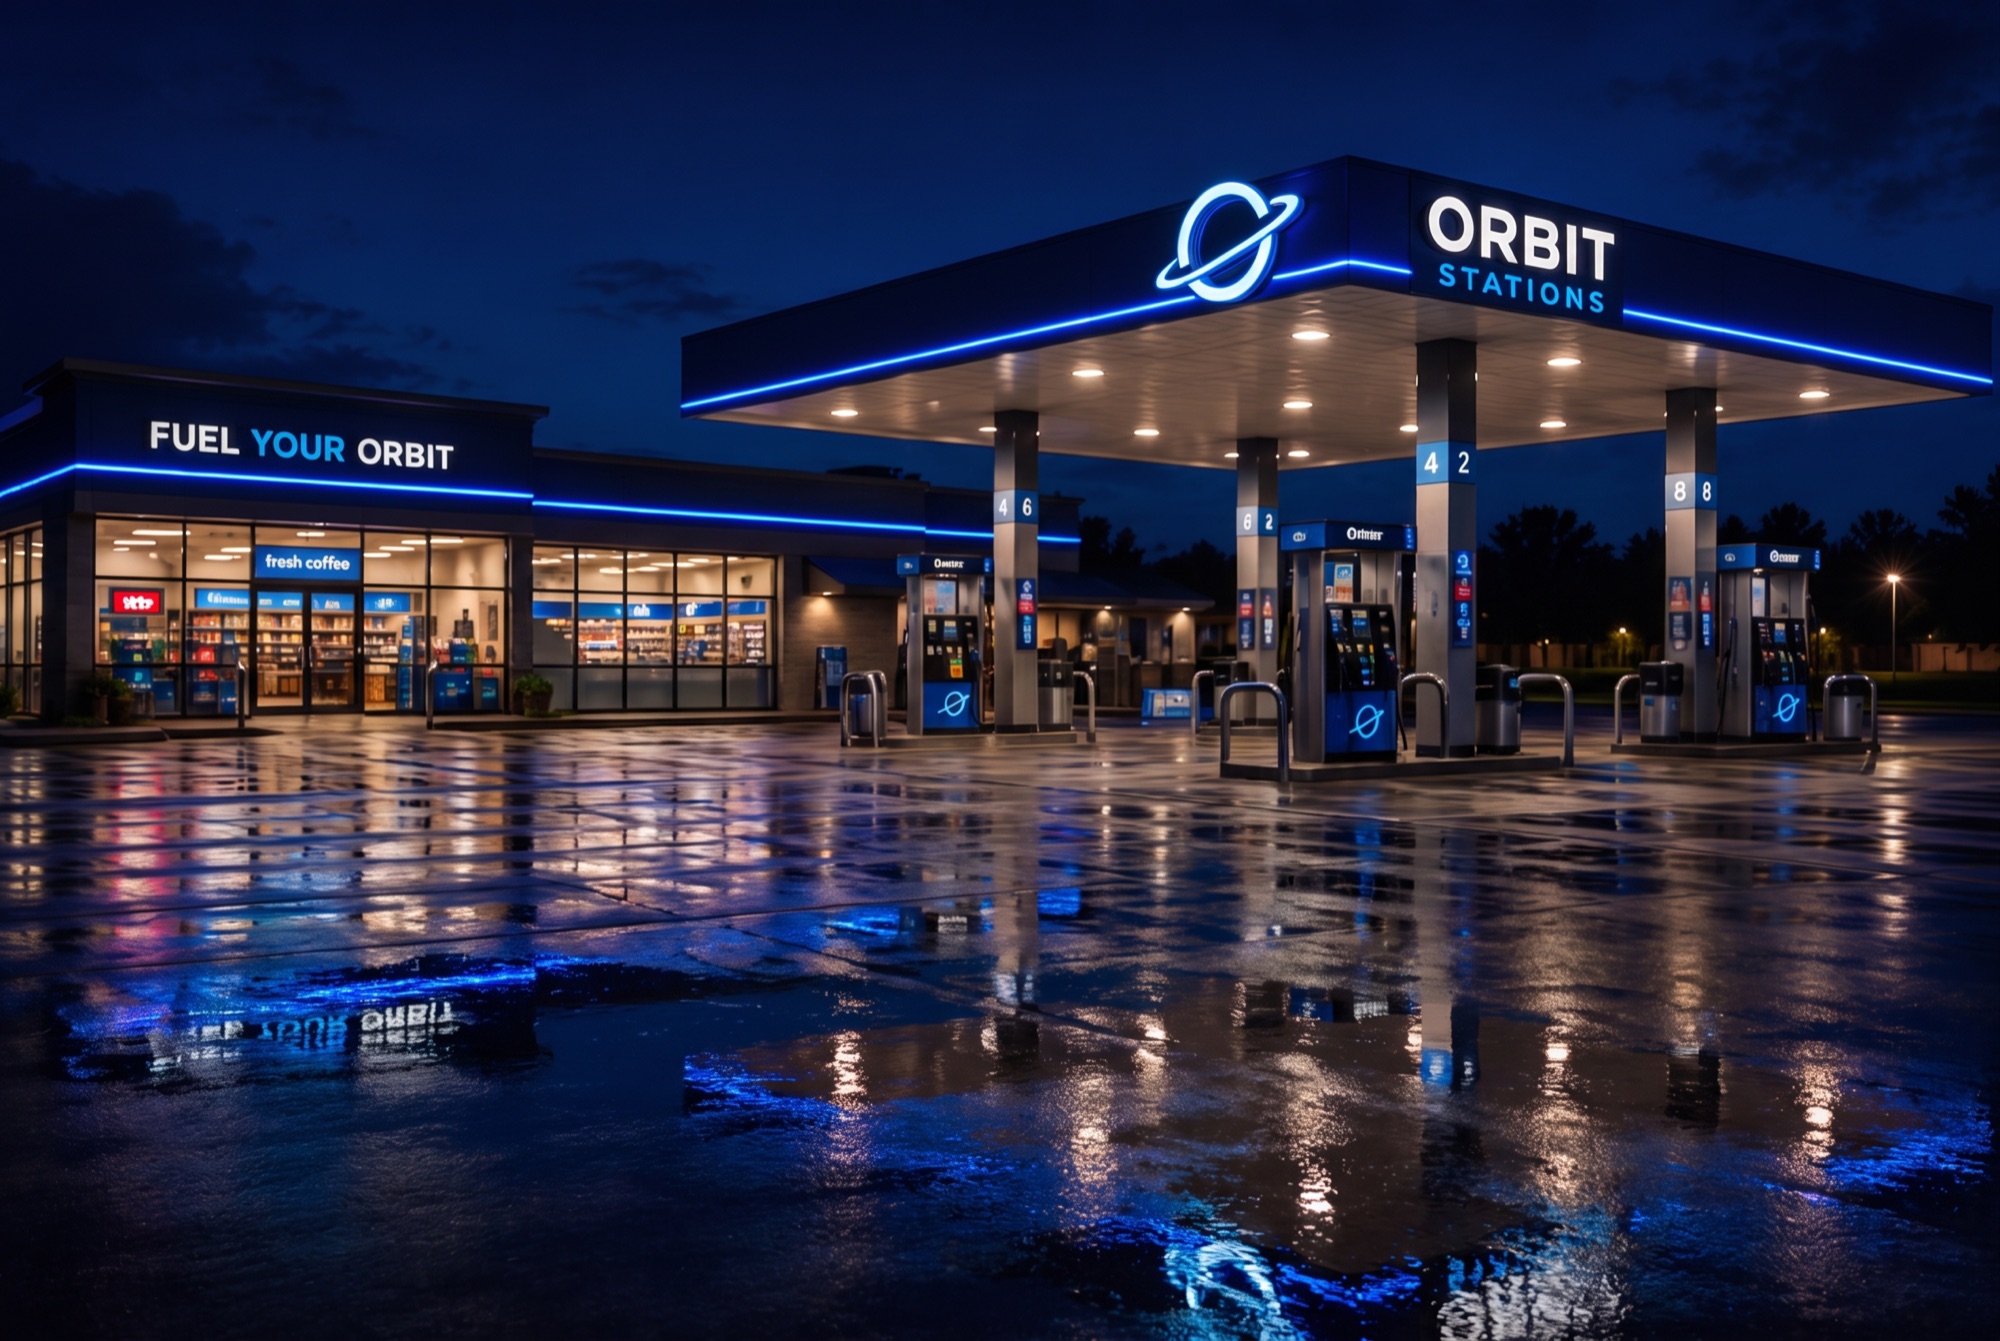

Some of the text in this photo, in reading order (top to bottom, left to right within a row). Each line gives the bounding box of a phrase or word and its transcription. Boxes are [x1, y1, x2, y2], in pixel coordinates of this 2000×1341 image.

[1428, 195, 1615, 281] ORBIT
[1439, 263, 1604, 313] STATIONS
[150, 421, 454, 470] FUEL YOUR ORBIT
[1424, 451, 1439, 474] 4
[1458, 450, 1470, 474] 2
[1673, 480, 1687, 502] 8
[1702, 481, 1712, 502] 8
[998, 498, 1008, 516] 4
[1022, 497, 1032, 516] 6
[1265, 513, 1273, 530] 2
[265, 554, 351, 570] fresh coffee
